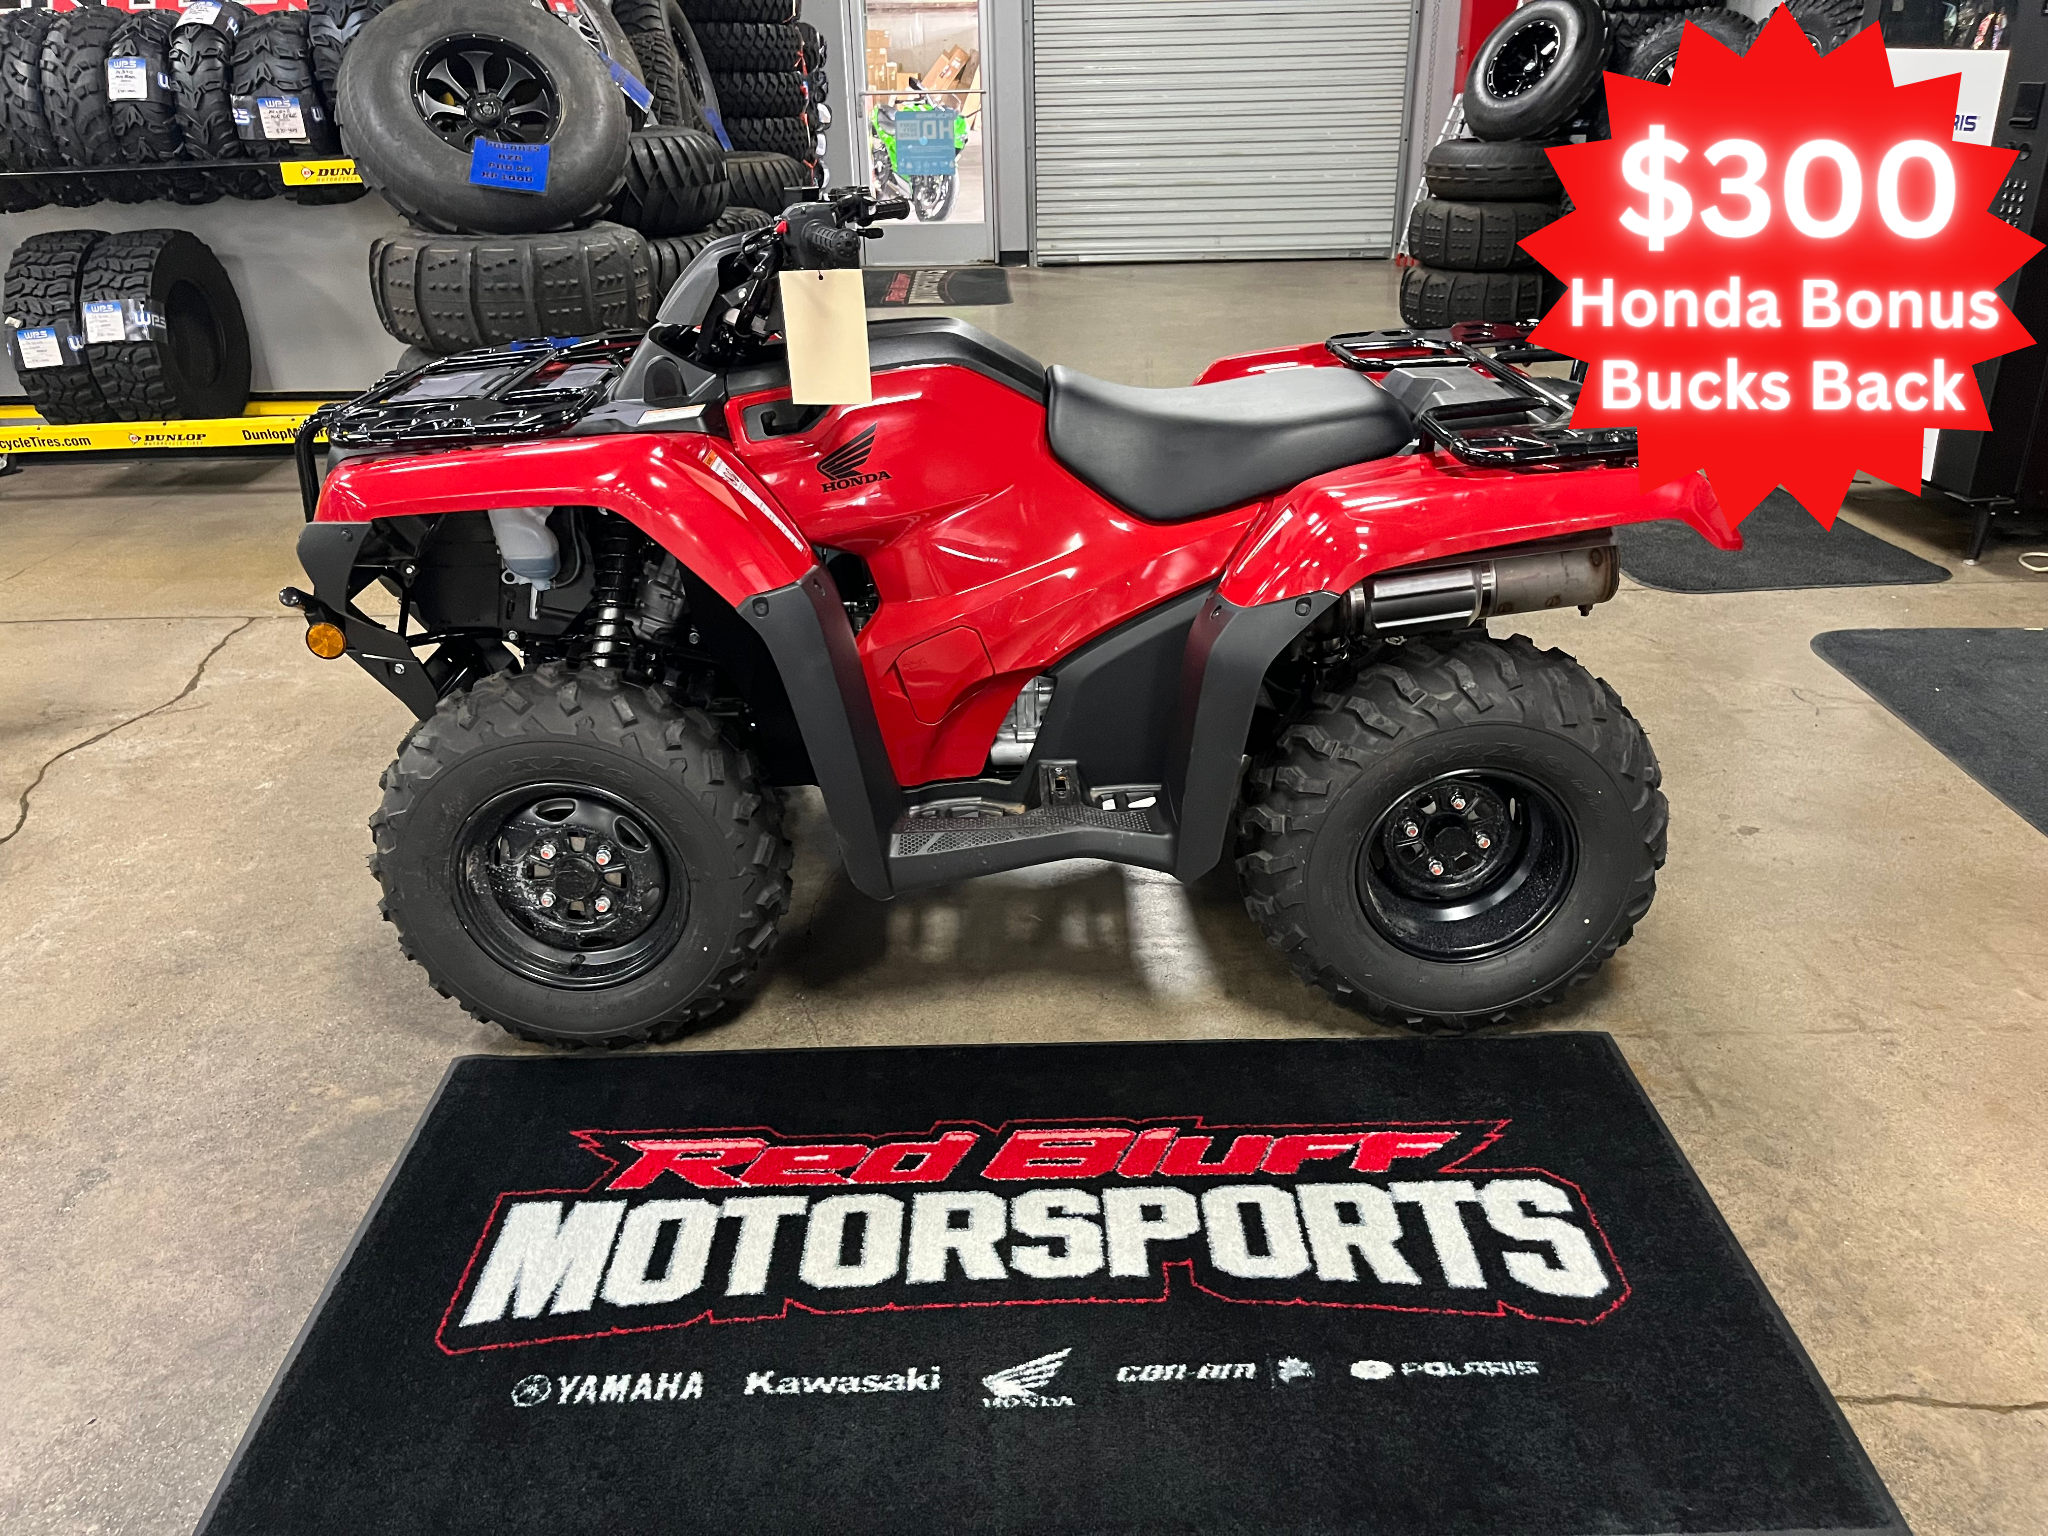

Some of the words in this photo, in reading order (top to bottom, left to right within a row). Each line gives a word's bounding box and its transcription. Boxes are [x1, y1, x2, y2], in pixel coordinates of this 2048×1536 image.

[113, 60, 137, 69] WPS
[265, 99, 291, 108] WPS
[485, 141, 540, 152] POLARIS
[91, 304, 114, 313] WPS
[24, 330, 48, 340] WPS
[144, 433, 207, 442] DUNLOP
[821, 470, 893, 493] HONDA
[605, 1131, 980, 1190] Red
[980, 1127, 1461, 1181] Bluff
[459, 1177, 1609, 1327] MOTORSPORTS
[743, 1365, 941, 1396] Kawasaki
[557, 1370, 704, 1405] YAMAHA
